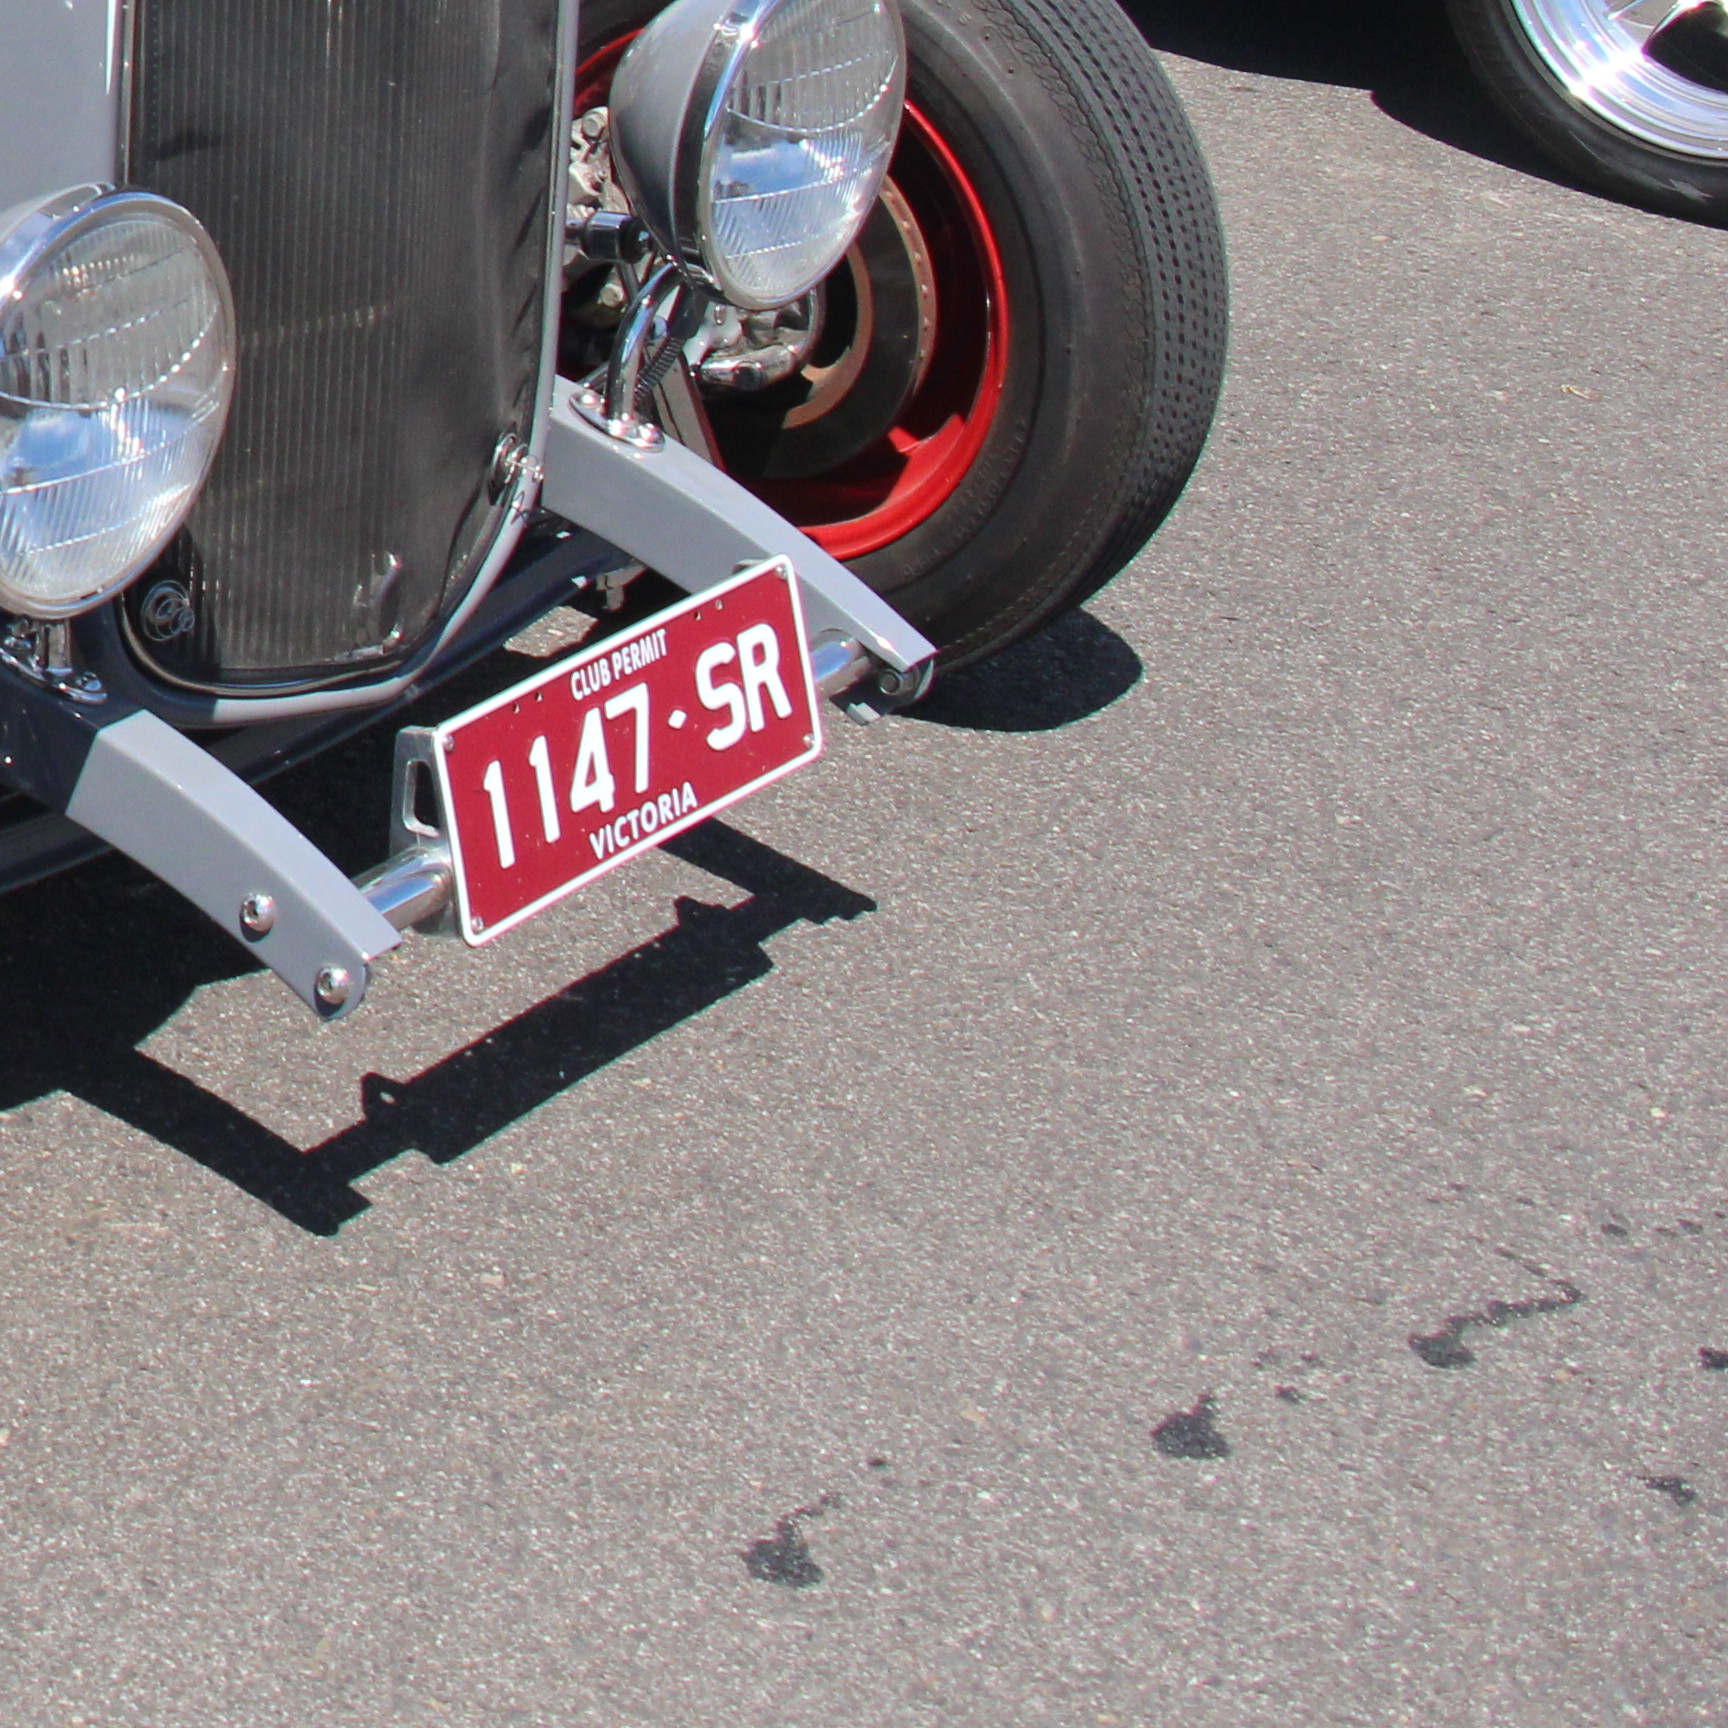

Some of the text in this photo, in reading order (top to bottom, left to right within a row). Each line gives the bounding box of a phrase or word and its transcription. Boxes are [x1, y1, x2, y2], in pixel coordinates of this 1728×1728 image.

[570, 628, 668, 701] CLUB PERMIT
[589, 781, 699, 860] VICTORIA
